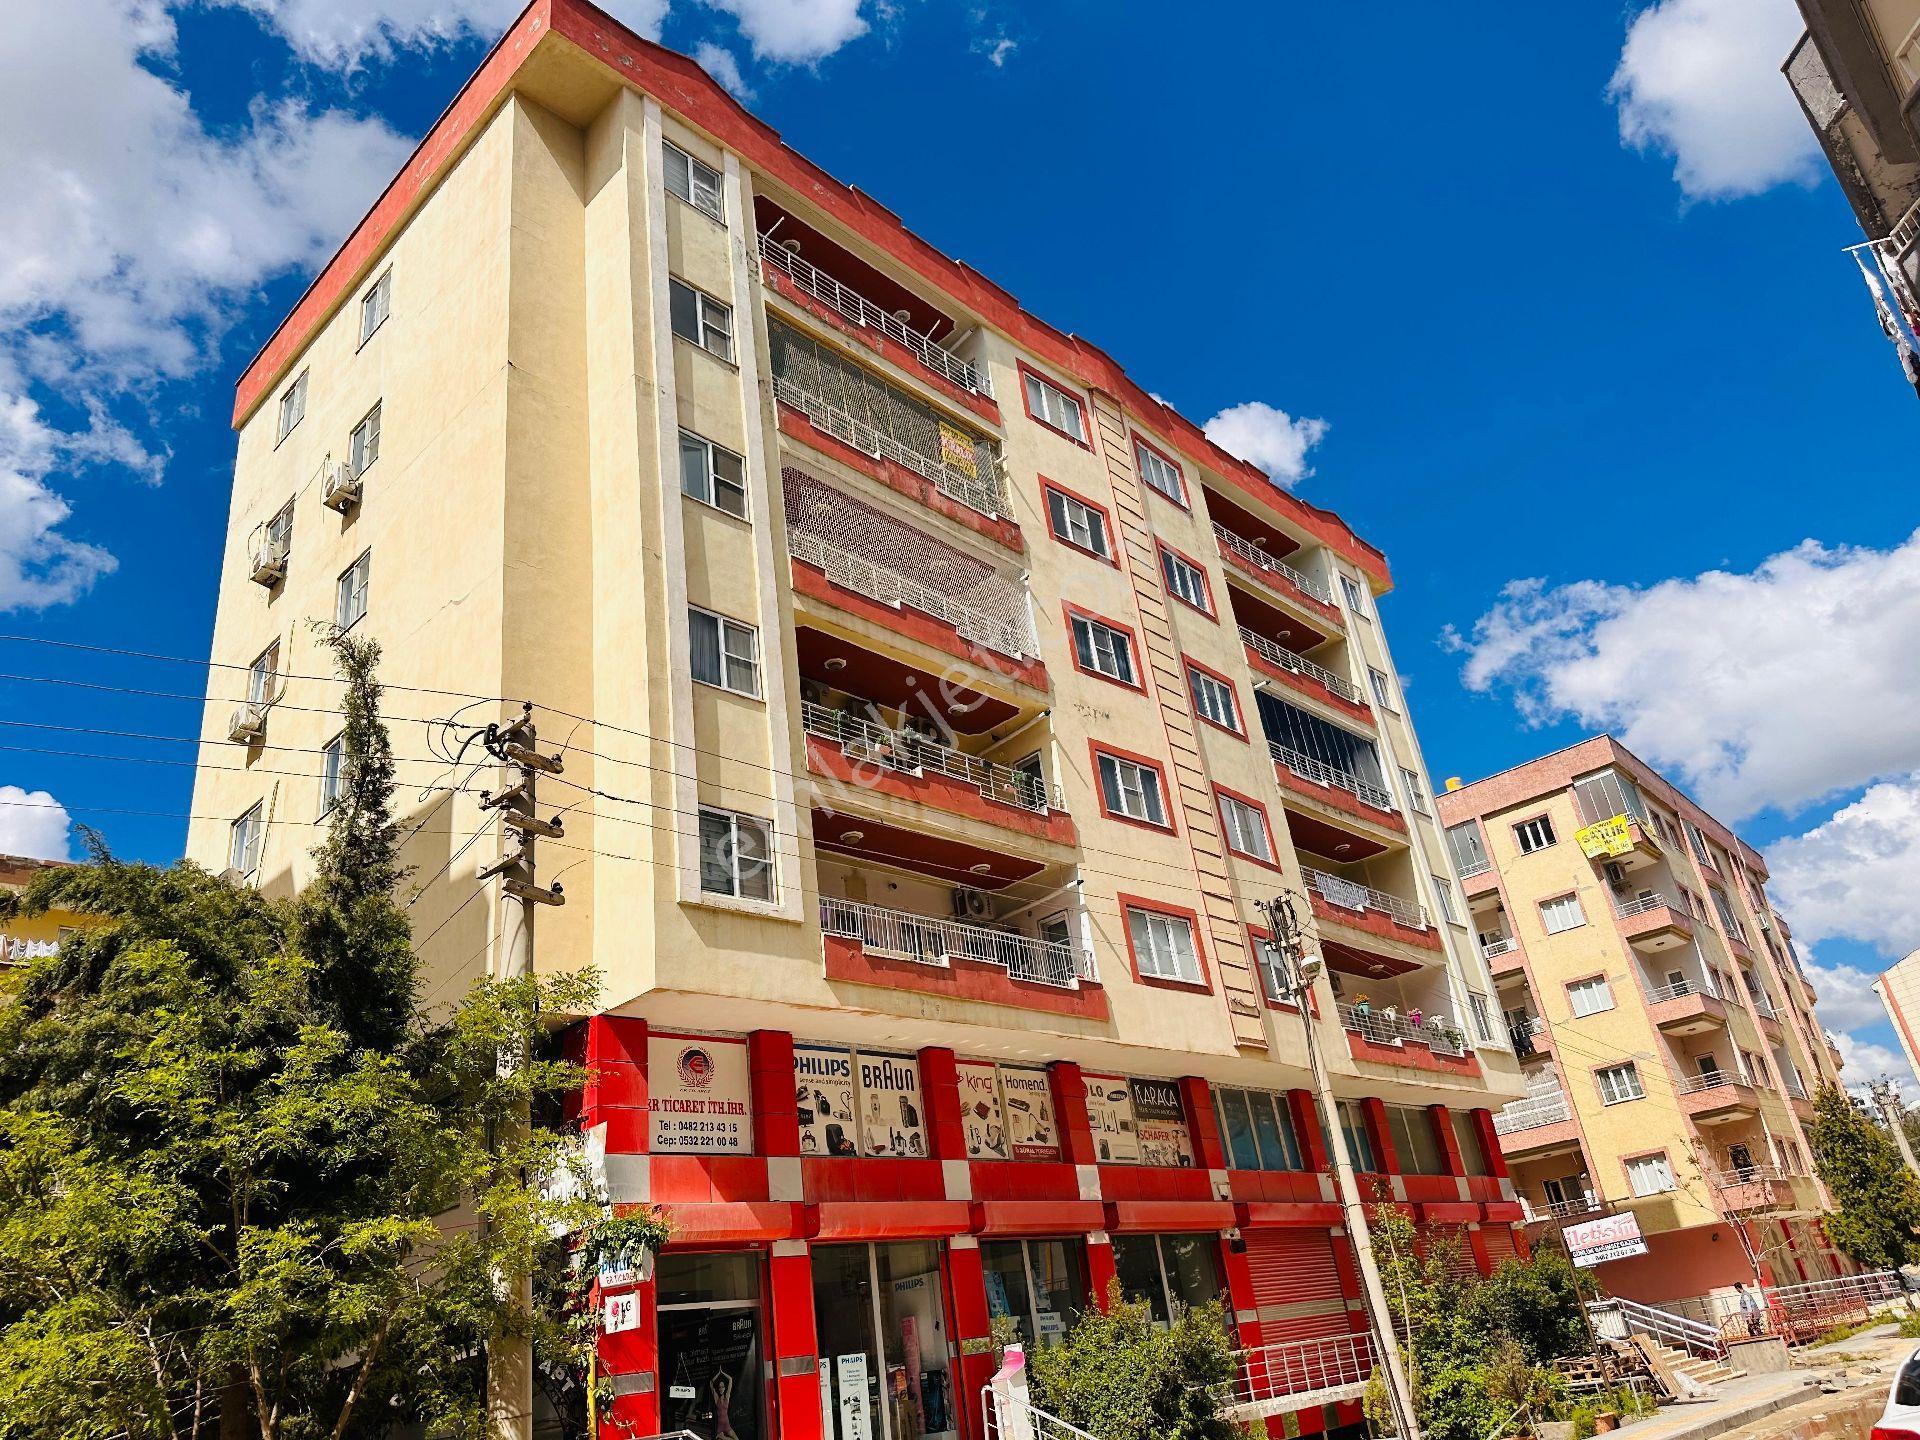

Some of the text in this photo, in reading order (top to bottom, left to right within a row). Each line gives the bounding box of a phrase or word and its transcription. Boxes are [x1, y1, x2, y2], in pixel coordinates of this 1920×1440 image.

[1581, 823, 1626, 843] SATILIK
[1090, 1085, 1103, 1098] LG
[1134, 1084, 1179, 1107] KARACA
[662, 1095, 705, 1113] TİCARET
[659, 1120, 671, 1130] Tel
[678, 1121, 697, 1131] 0482
[700, 1122, 714, 1132] 213
[716, 1123, 725, 1132] 43
[728, 1123, 737, 1132] 15
[657, 1135, 676, 1147] Cep:
[678, 1135, 698, 1146] 0532
[700, 1136, 714, 1146] 221
[717, 1137, 727, 1147] 00
[602, 1257, 633, 1274] PHILIP
[895, 1278, 924, 1291] PHILIPS
[621, 1300, 632, 1312] LG
